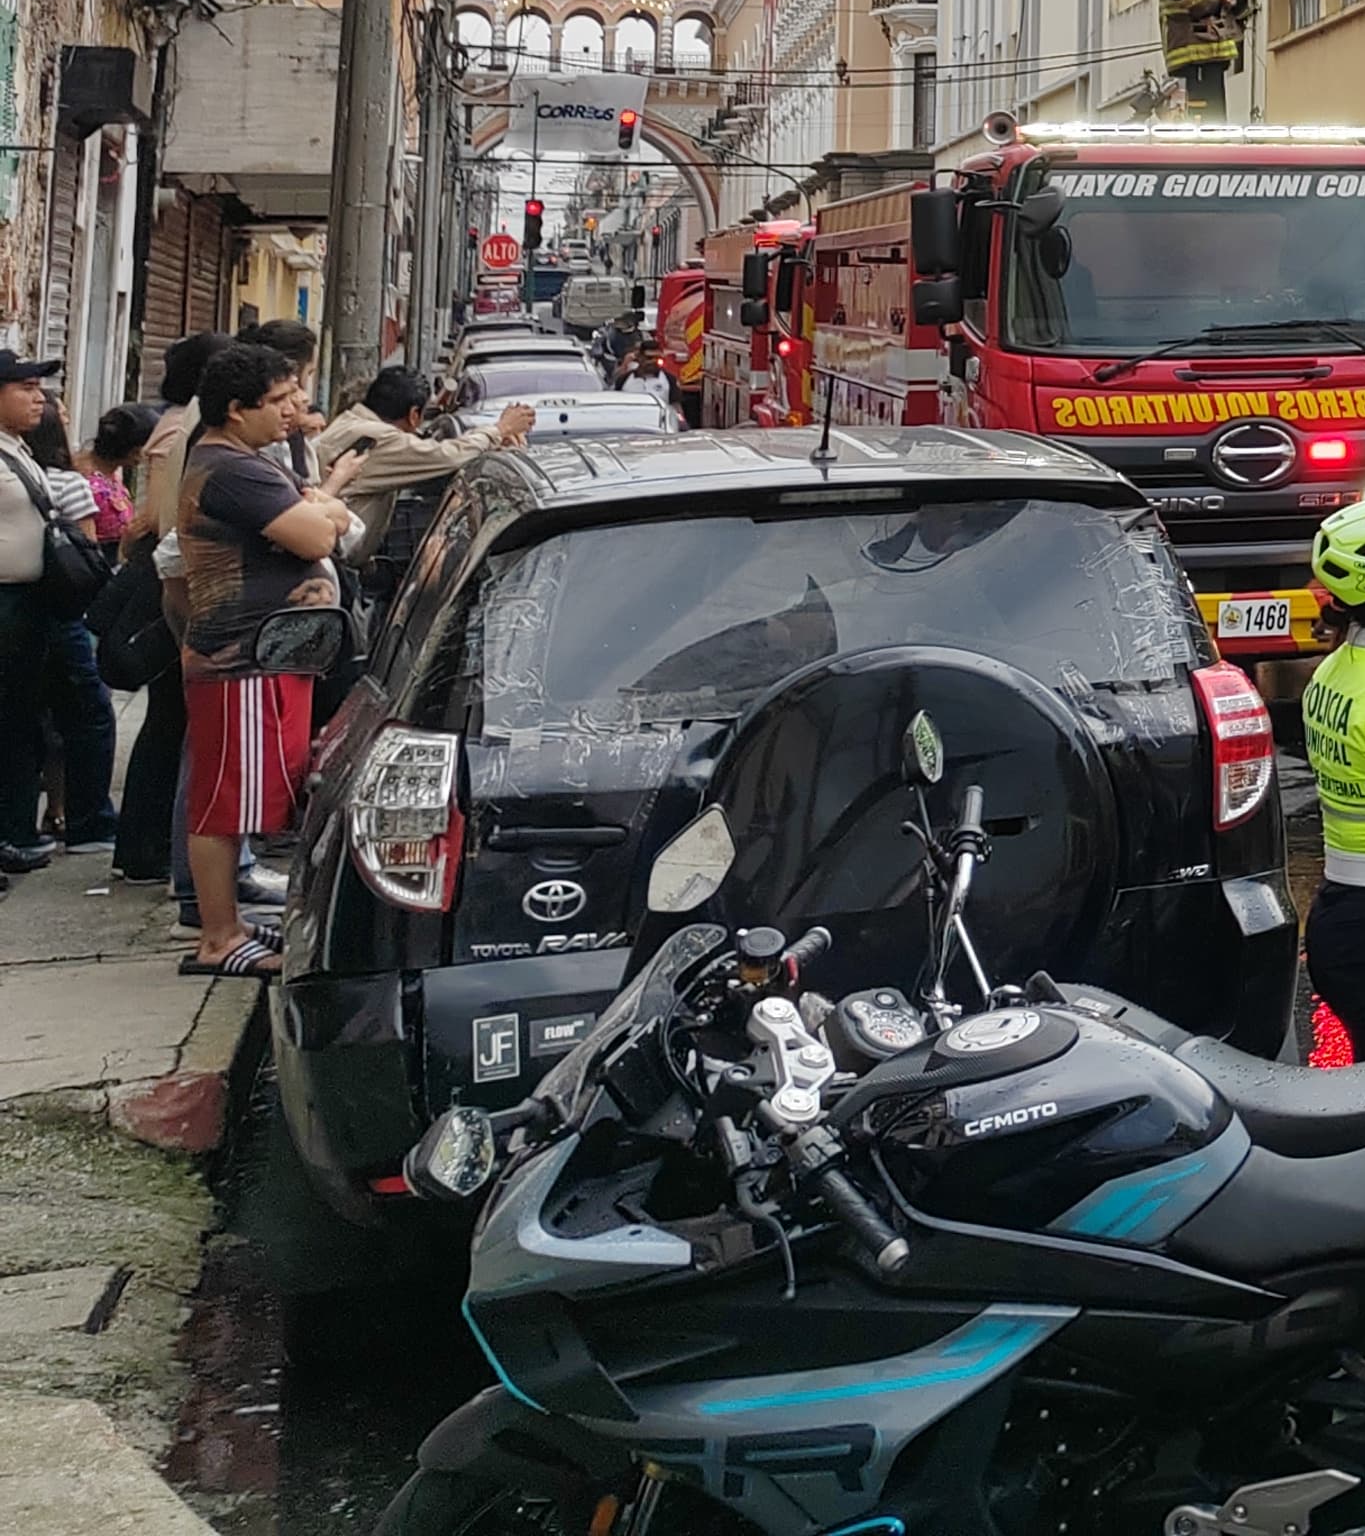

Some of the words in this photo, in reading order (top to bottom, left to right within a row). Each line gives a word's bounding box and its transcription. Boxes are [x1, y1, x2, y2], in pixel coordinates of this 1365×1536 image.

[537, 103, 616, 121] CORREOS
[1047, 173, 1156, 199] MAYOR
[1161, 173, 1309, 199] GIOVANNI
[484, 242, 517, 261] ALTO
[1146, 495, 1225, 512] HINO
[1245, 603, 1288, 633] 1468
[1305, 722, 1352, 767] UNICIPAL
[470, 942, 533, 958] TOYOTA
[479, 1030, 514, 1067] JF
[964, 1101, 1058, 1137] CFMOTO
